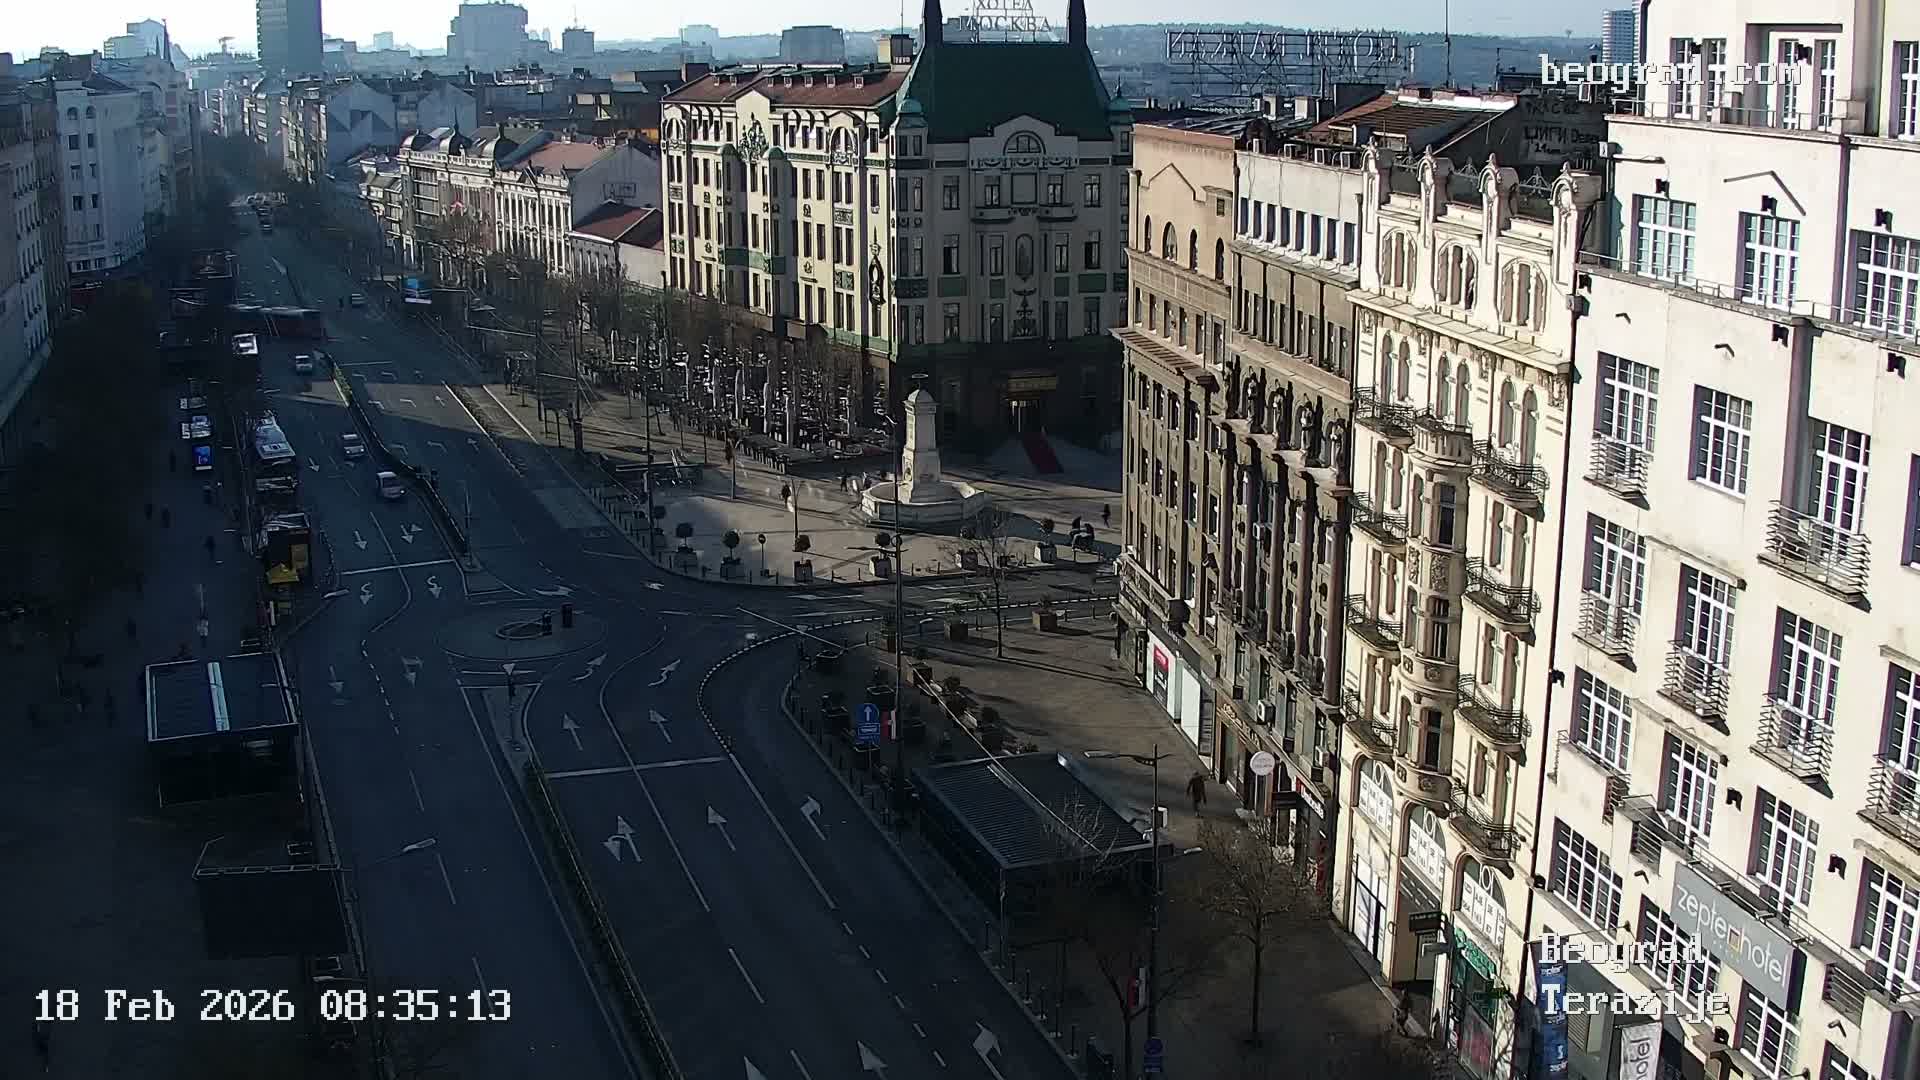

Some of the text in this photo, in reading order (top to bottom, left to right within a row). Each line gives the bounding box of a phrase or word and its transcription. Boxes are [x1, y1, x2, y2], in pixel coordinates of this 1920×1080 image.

[976, 0, 1034, 10] ХОТЕЛ
[959, 15, 1052, 32] МОСКВА
[1739, 924, 1789, 989] hotel
